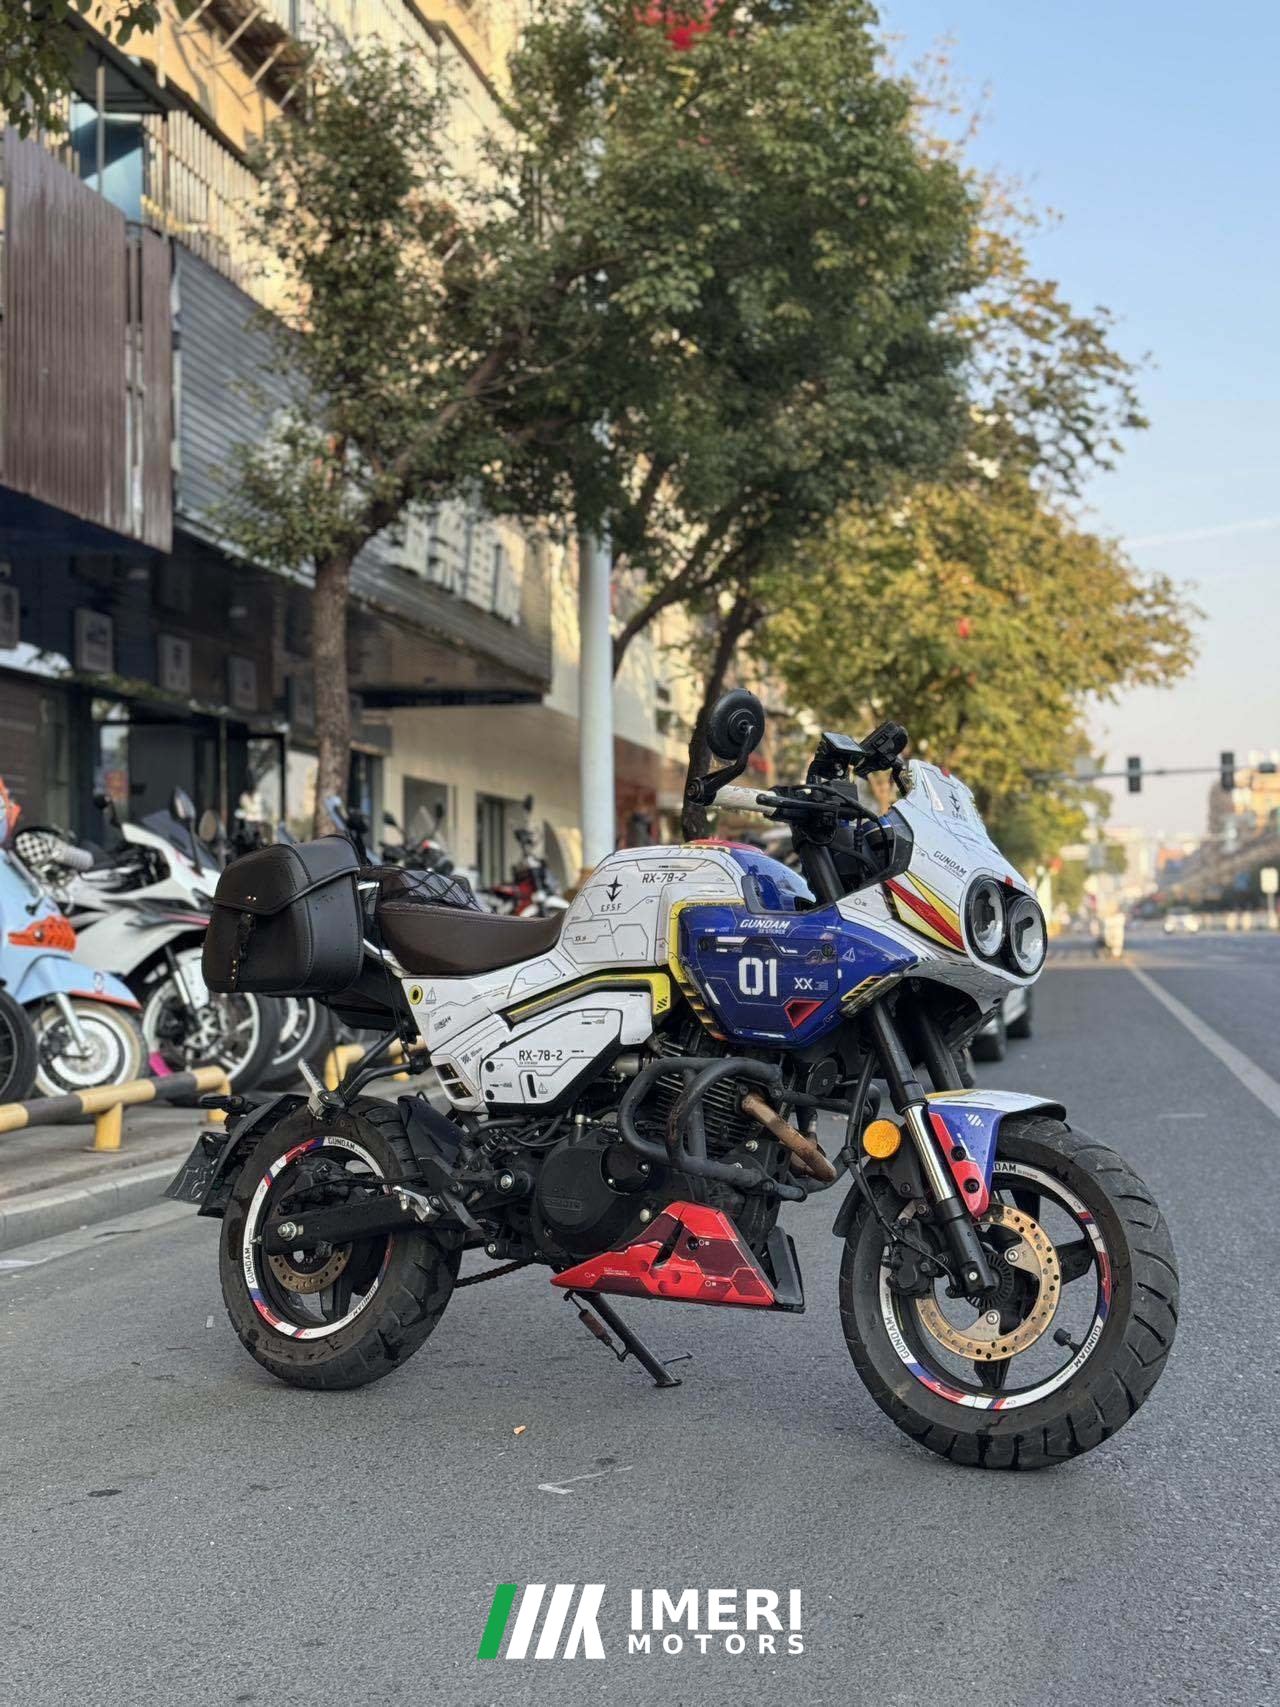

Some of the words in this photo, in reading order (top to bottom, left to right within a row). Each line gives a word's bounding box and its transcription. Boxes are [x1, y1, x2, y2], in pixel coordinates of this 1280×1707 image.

[933, 850, 967, 876] GUNDAM
[641, 872, 687, 885] RX-78-2
[739, 919, 791, 930] GUNDAM
[738, 957, 778, 997] 01
[793, 976, 814, 991] XX
[518, 1049, 564, 1061] RX-78-2
[327, 1136, 356, 1150] GUNDAM
[993, 1161, 1017, 1174] DAM
[245, 1246, 255, 1284] GUNDAM
[884, 1316, 910, 1360] GUNDAM
[1072, 1324, 1102, 1369] GUNDAM
